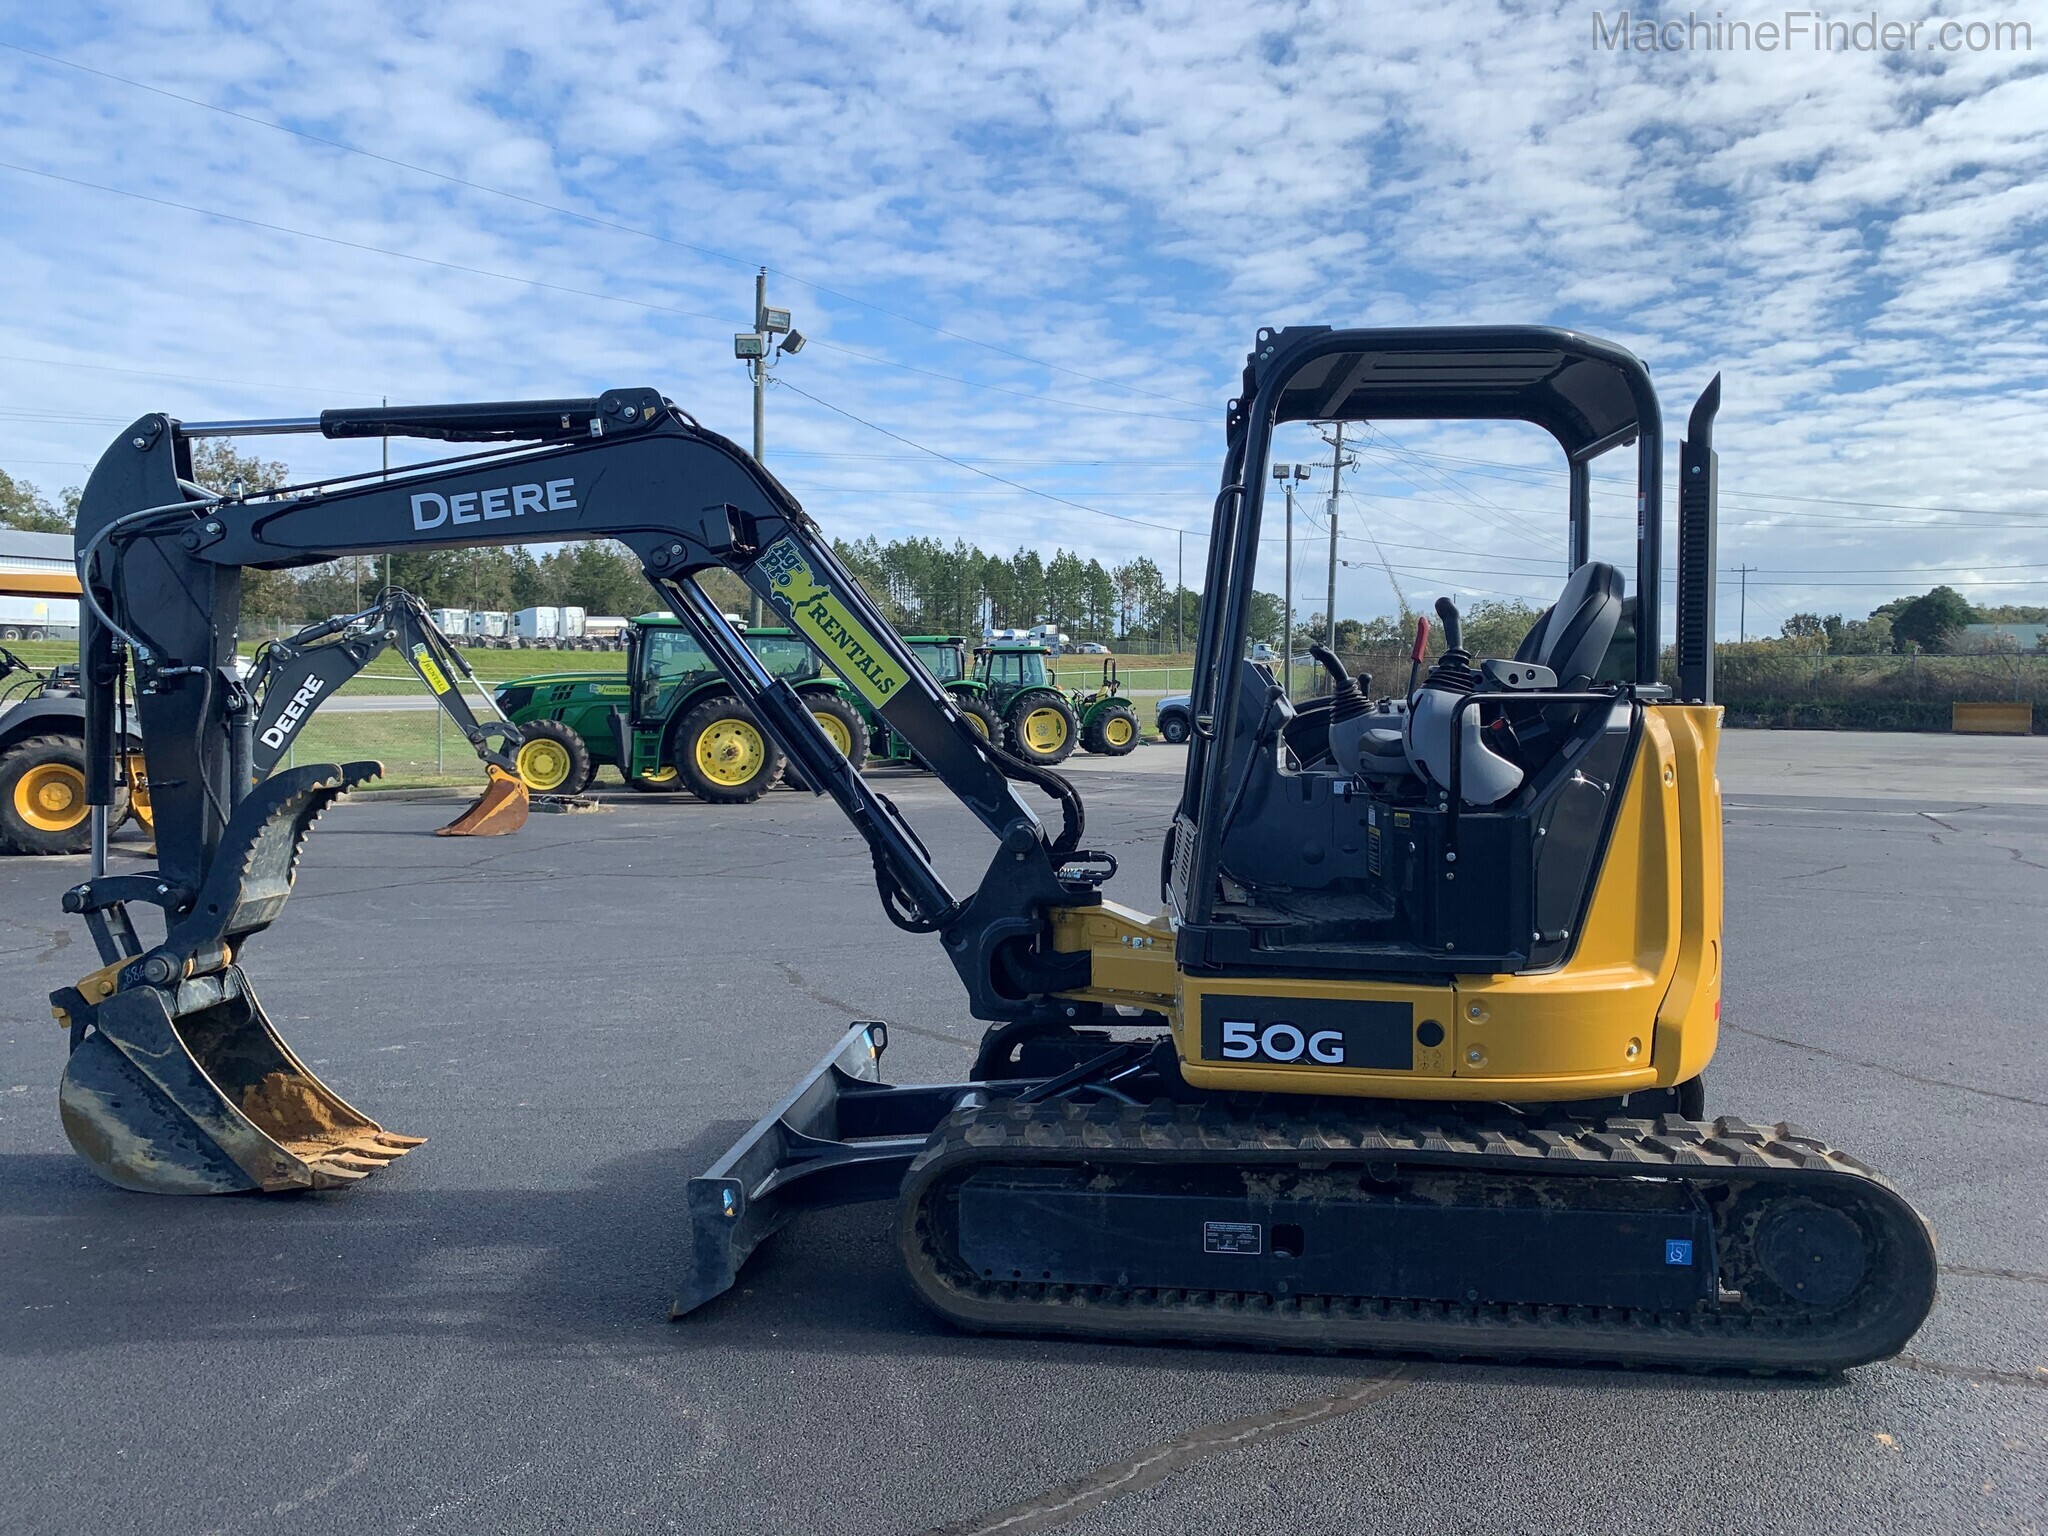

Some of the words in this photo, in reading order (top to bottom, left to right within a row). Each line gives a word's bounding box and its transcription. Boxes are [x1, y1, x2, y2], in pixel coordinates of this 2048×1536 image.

[410, 478, 577, 530] DEERE
[758, 551, 792, 587] Pro
[772, 541, 804, 574] Ag-
[808, 603, 896, 694] RENTALS
[424, 662, 446, 692] RENTALS
[259, 673, 325, 750] DEERE
[1223, 1021, 1344, 1064] 50G
